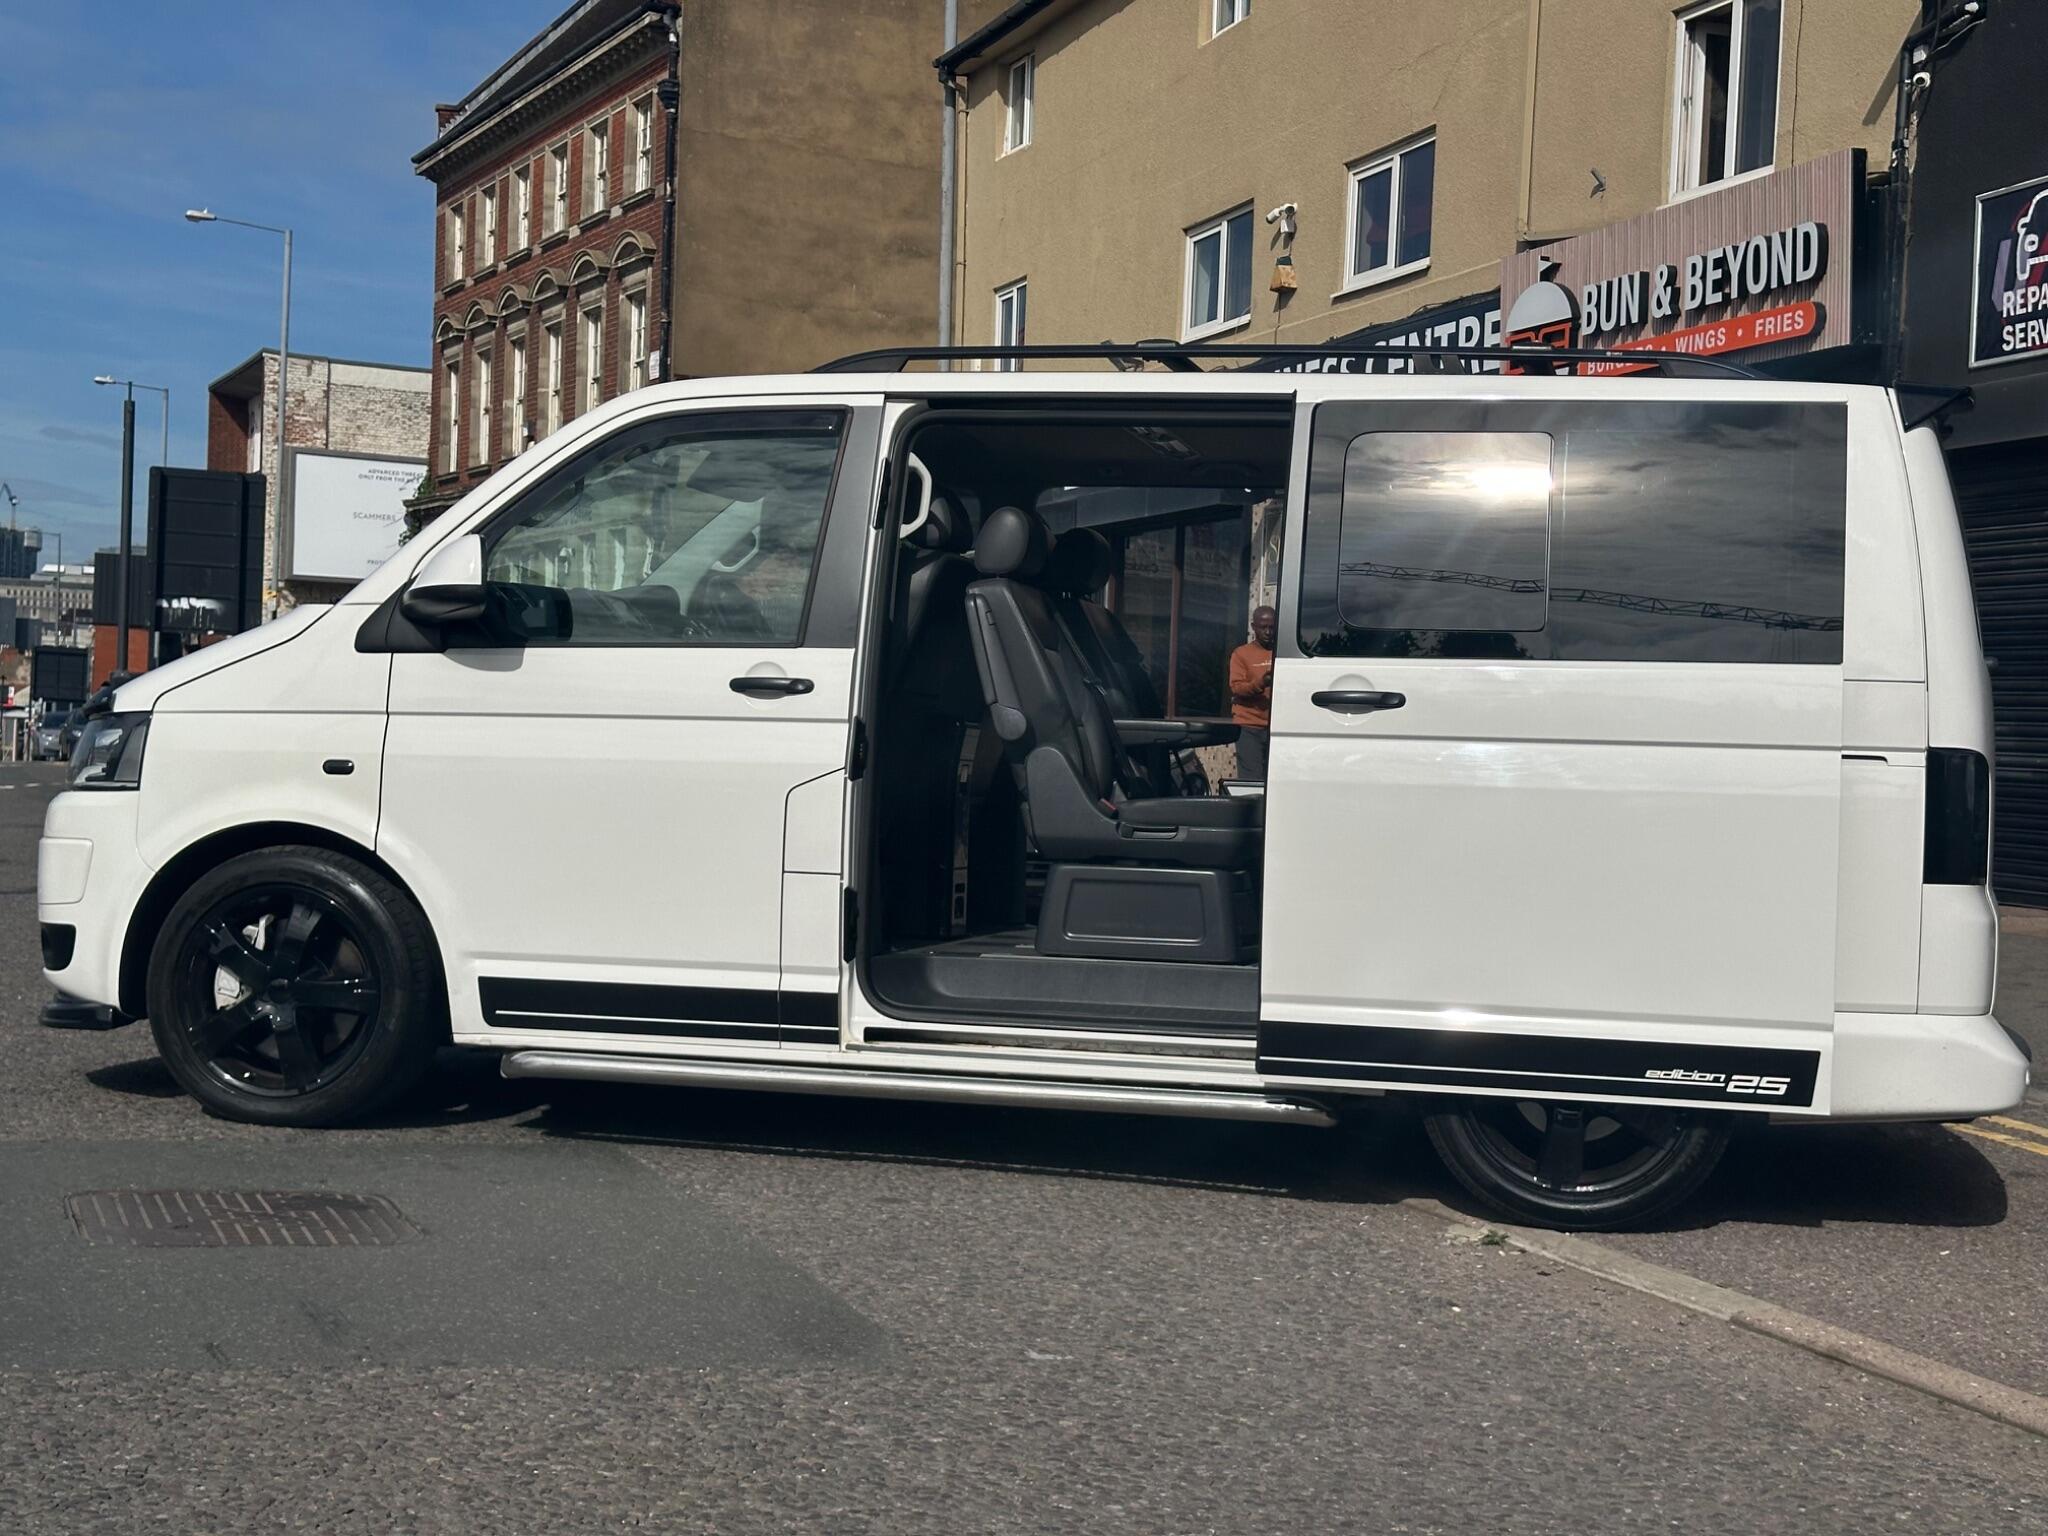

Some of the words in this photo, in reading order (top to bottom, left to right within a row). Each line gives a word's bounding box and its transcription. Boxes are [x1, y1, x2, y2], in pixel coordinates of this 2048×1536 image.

[1582, 271, 1641, 336] BUN
[1652, 264, 1672, 319] &
[1685, 221, 1818, 311] BEYOND
[1675, 327, 1726, 352] WINGS
[1755, 310, 1804, 338] FRIES
[353, 511, 396, 522] SCAMMERS
[1645, 1069, 1725, 1082] edition
[1726, 1074, 1791, 1095] 25
